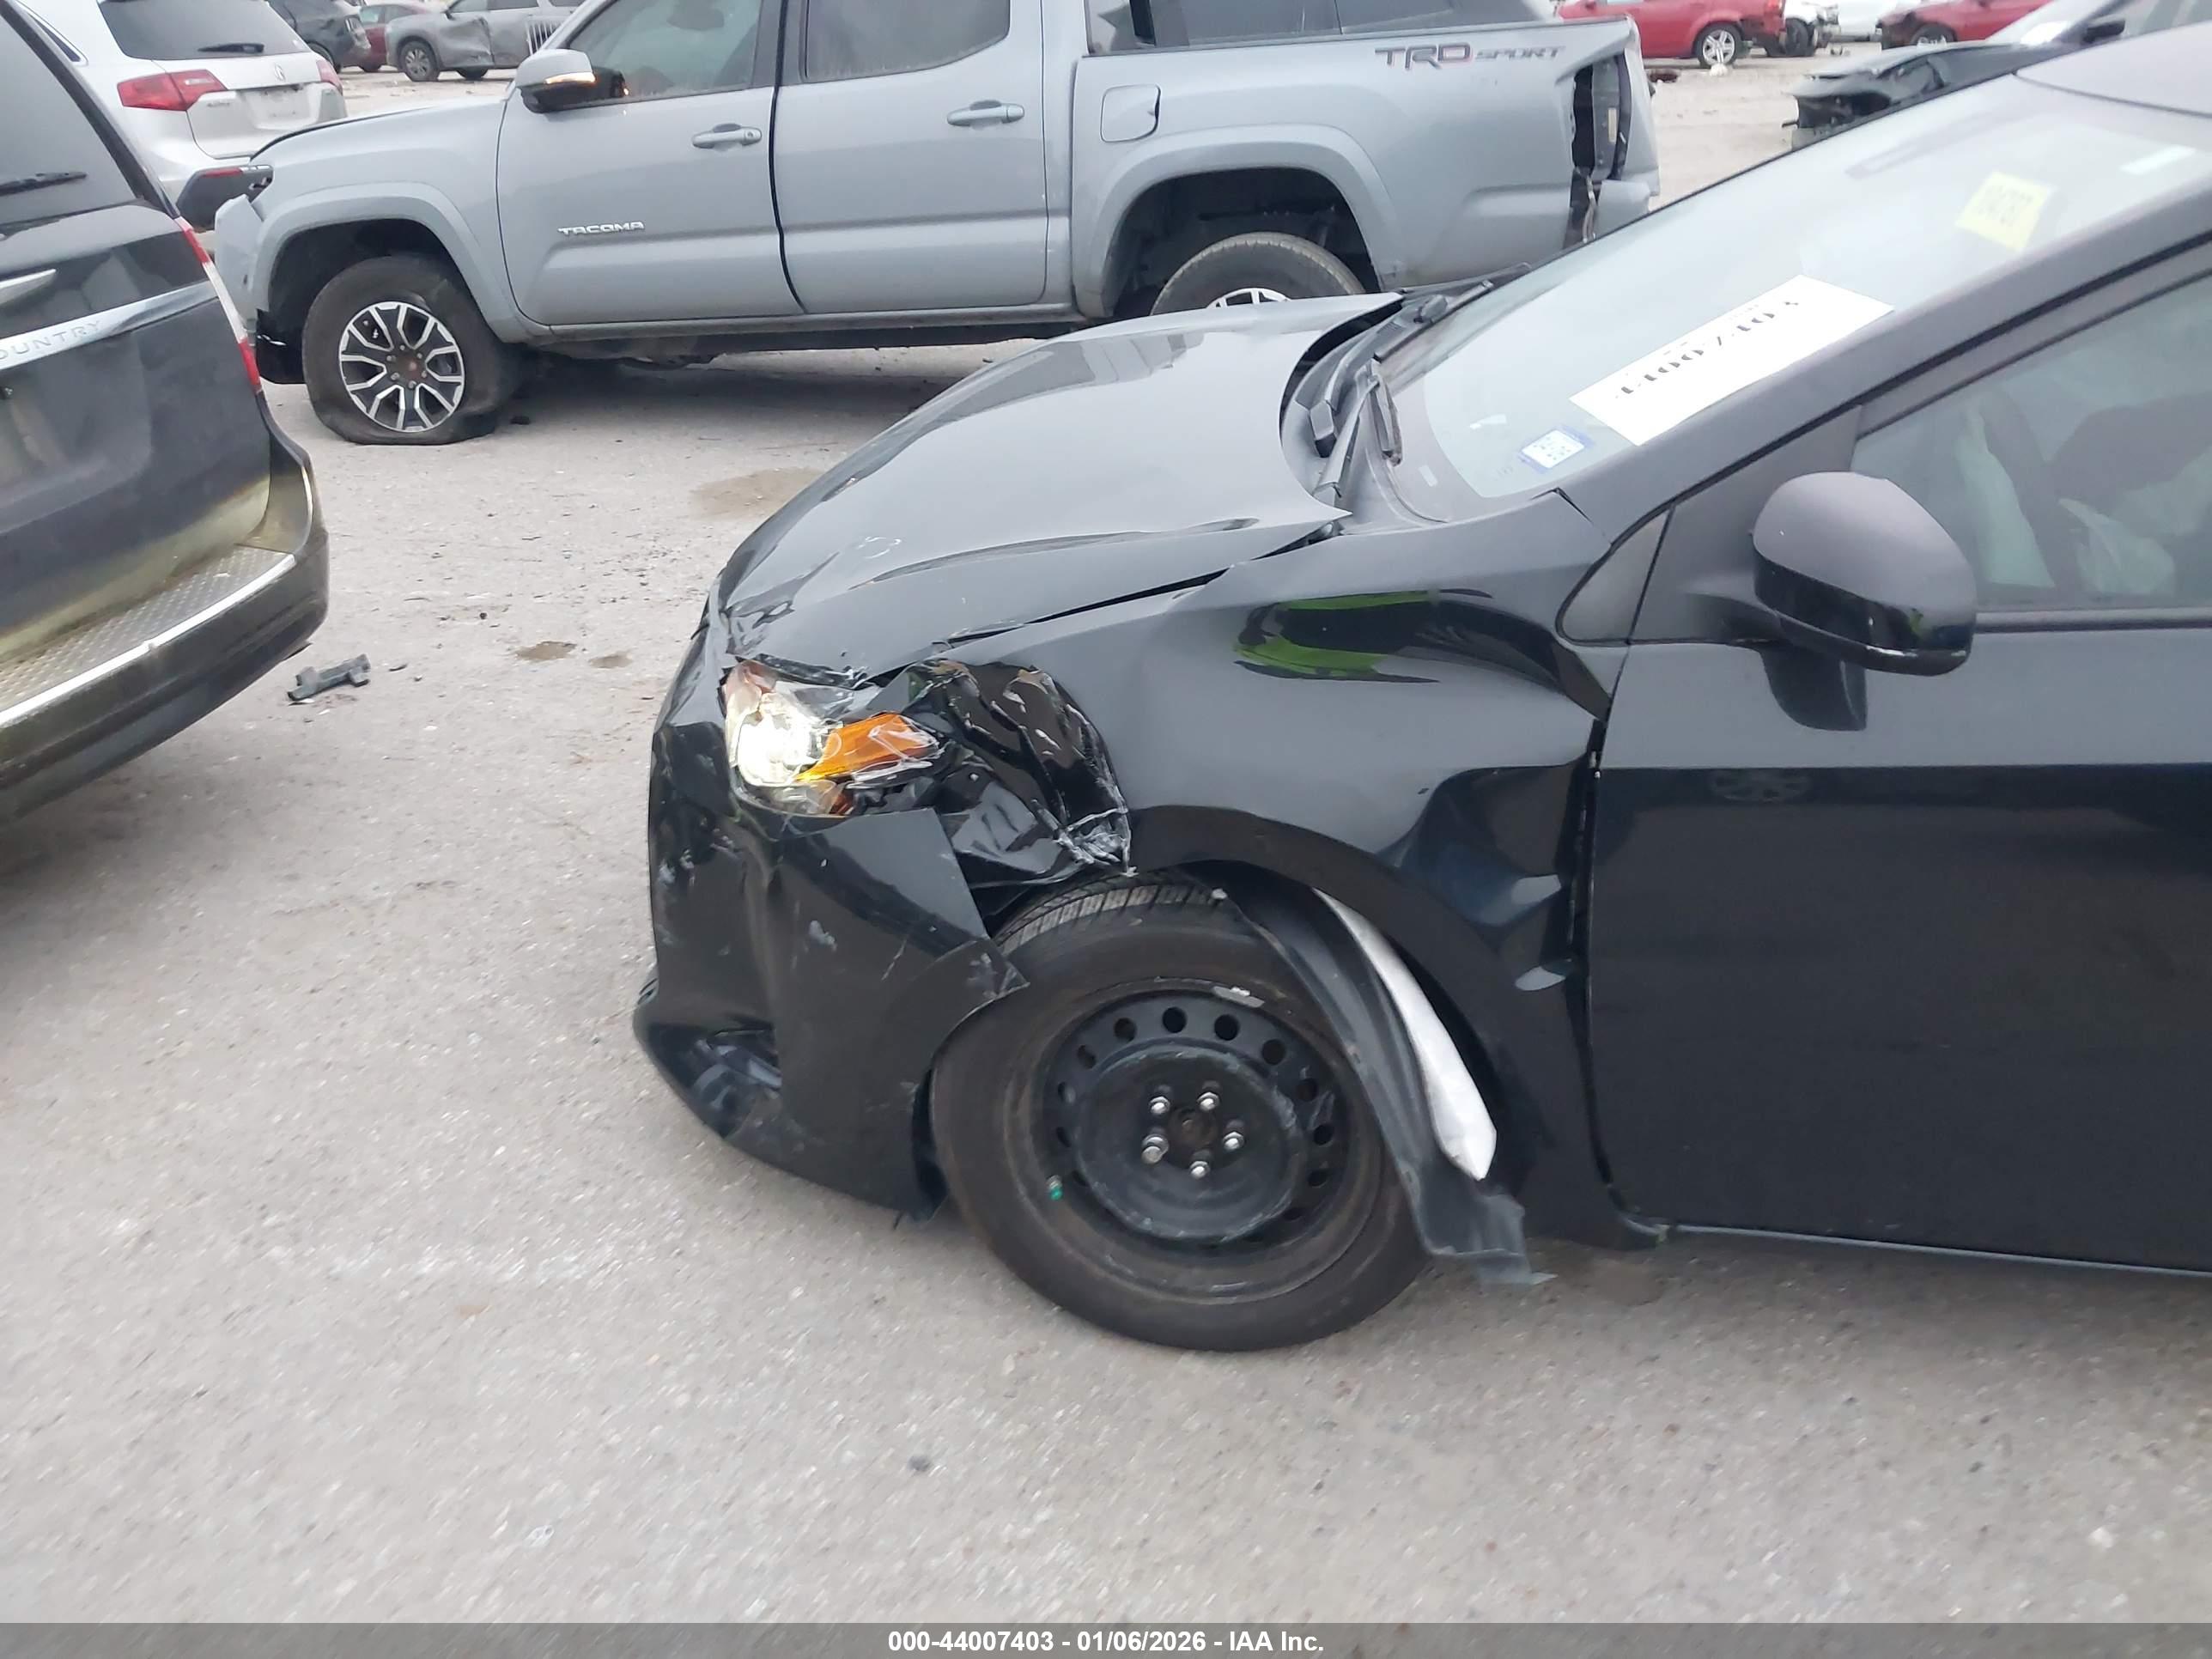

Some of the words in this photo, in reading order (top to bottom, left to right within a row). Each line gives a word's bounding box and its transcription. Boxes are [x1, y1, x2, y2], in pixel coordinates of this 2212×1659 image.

[1375, 42, 1472, 70] TRD
[1476, 46, 1565, 61] SPORT
[557, 221, 645, 236] TACOMA
